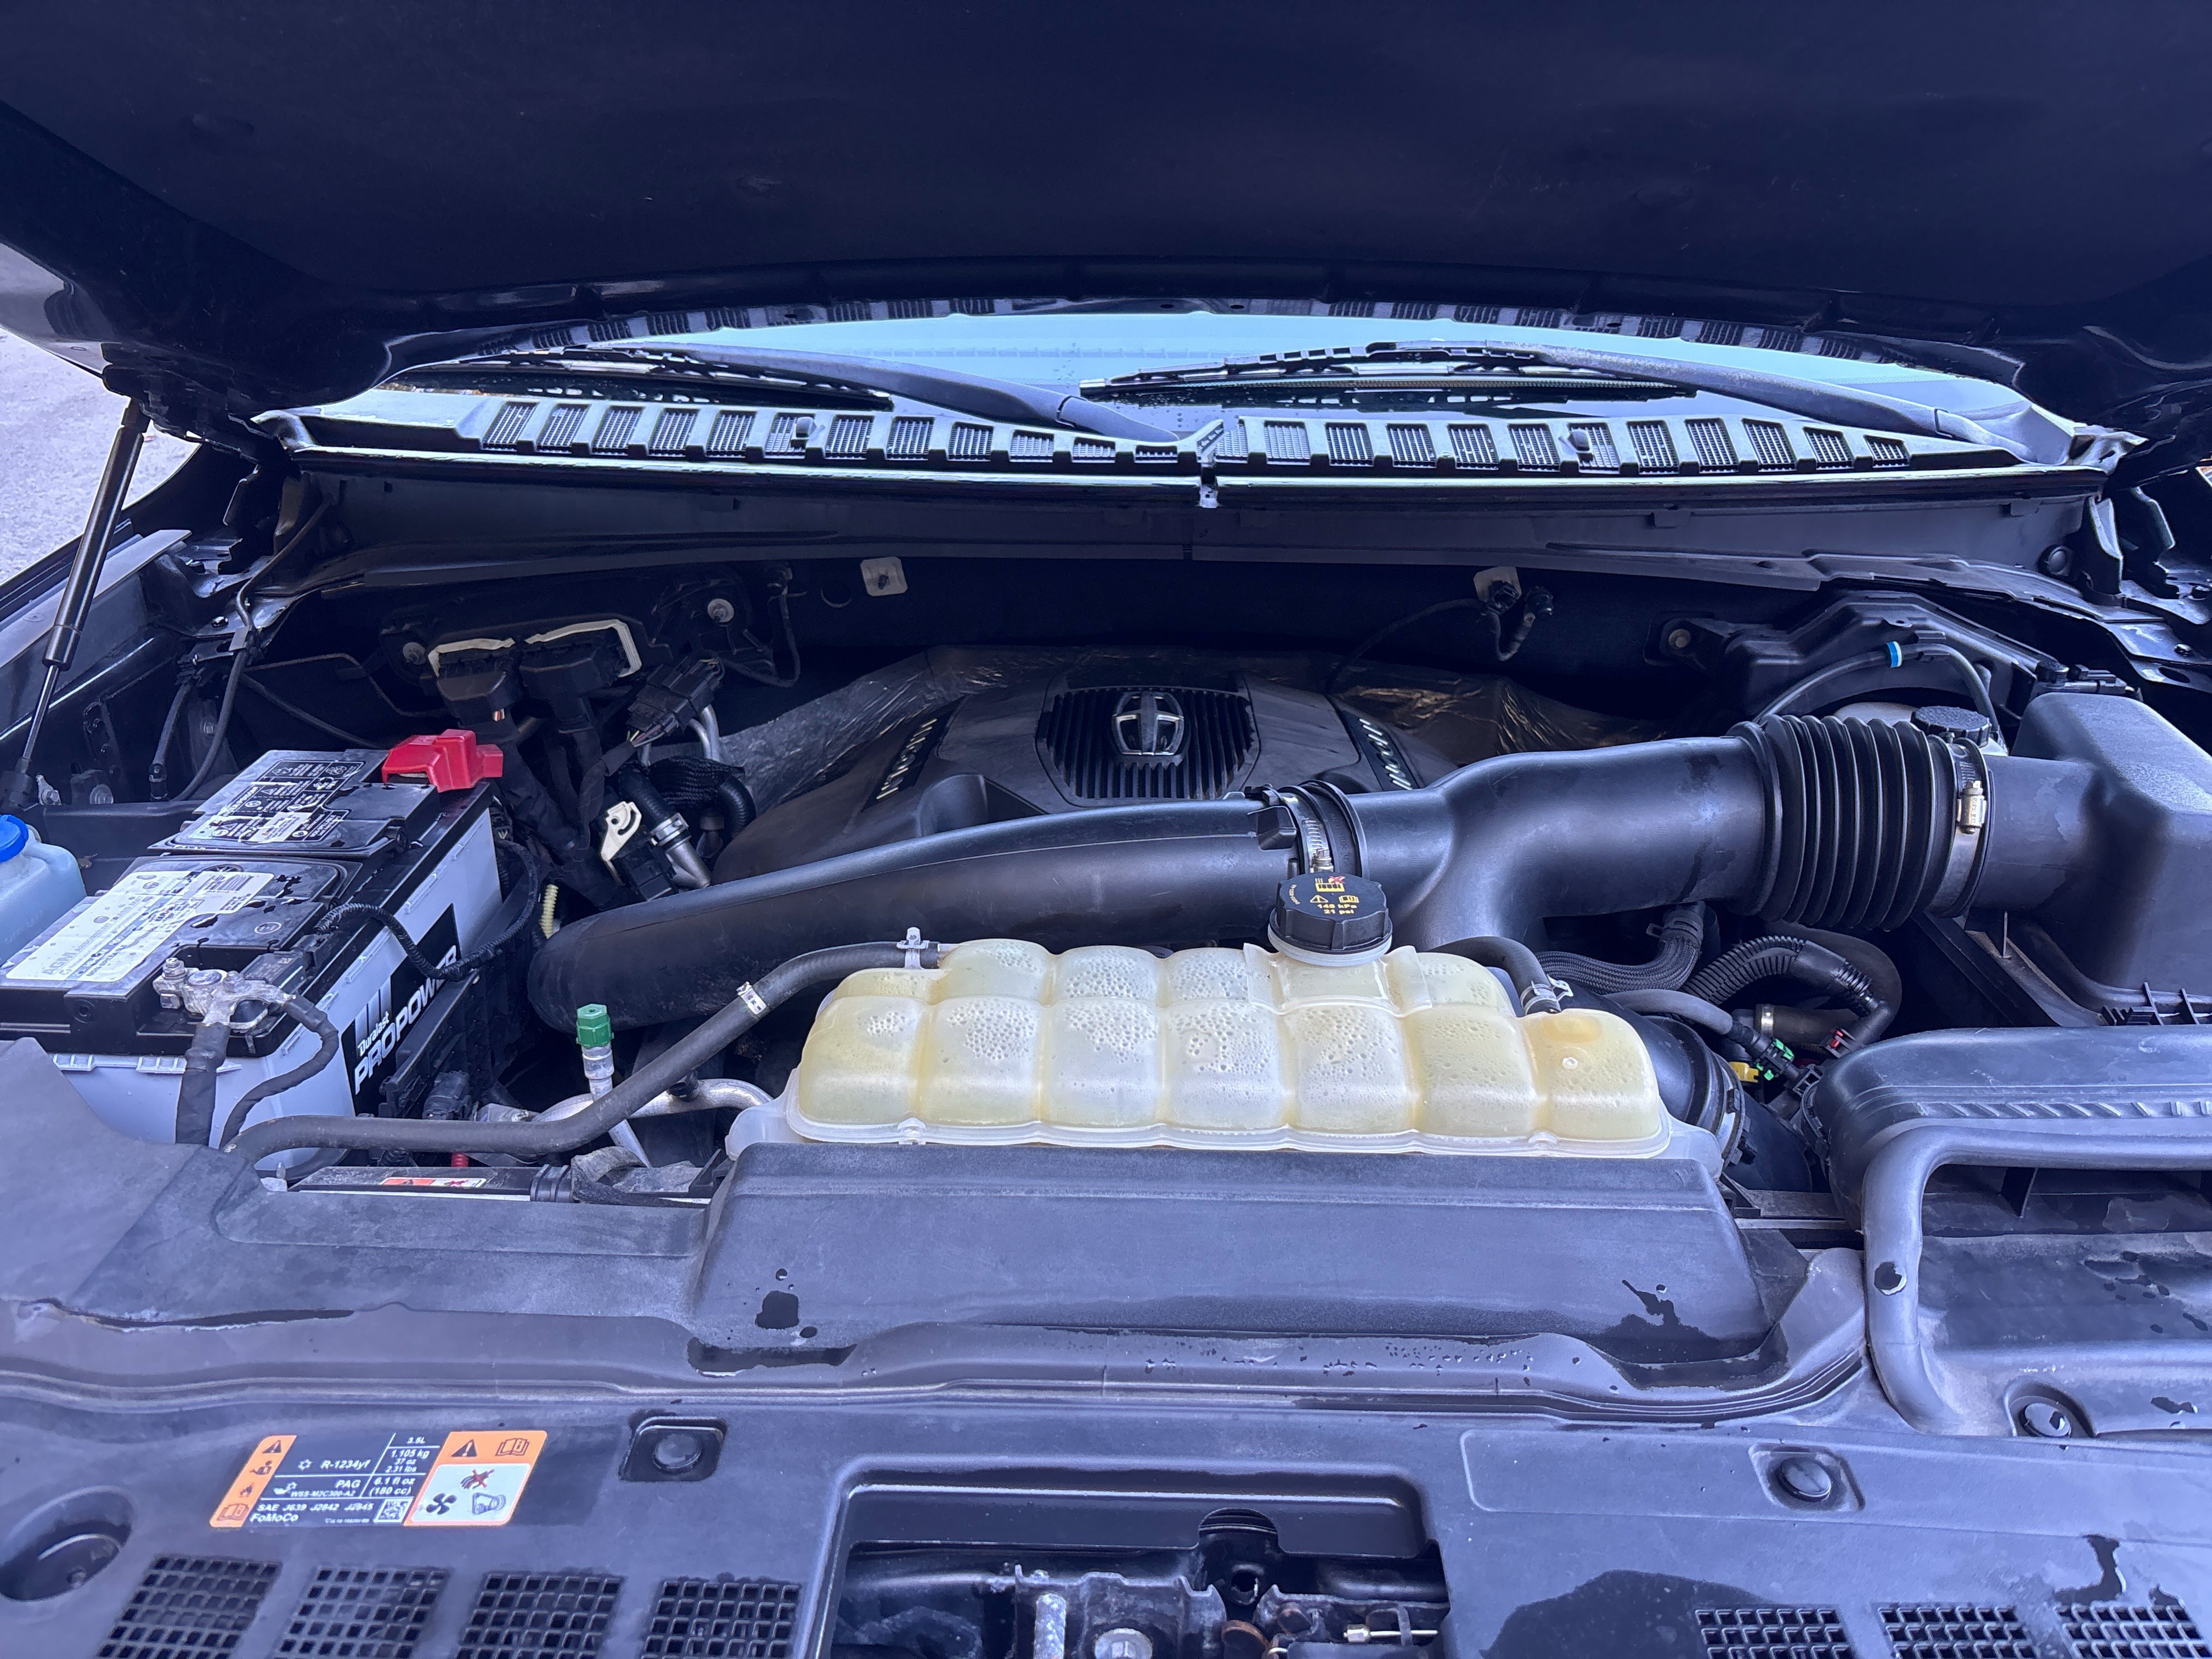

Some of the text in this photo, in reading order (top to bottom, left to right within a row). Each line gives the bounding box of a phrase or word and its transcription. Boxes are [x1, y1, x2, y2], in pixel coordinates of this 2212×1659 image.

[109, 936, 125, 946] 900
[42, 952, 78, 975] AGM
[357, 1011, 390, 1057] Duralast
[391, 1449, 430, 1459] 1.105 kg
[320, 1459, 371, 1470] R-1234yf
[335, 1479, 362, 1489] PAG
[374, 1477, 391, 1486] 6.1
[392, 1476, 401, 1485] fl
[369, 1487, 412, 1497] (180 cc)
[256, 1504, 280, 1512] SAE
[281, 1503, 307, 1512] J639
[343, 1503, 375, 1511] J2845
[250, 1513, 300, 1523] FoMoCo
